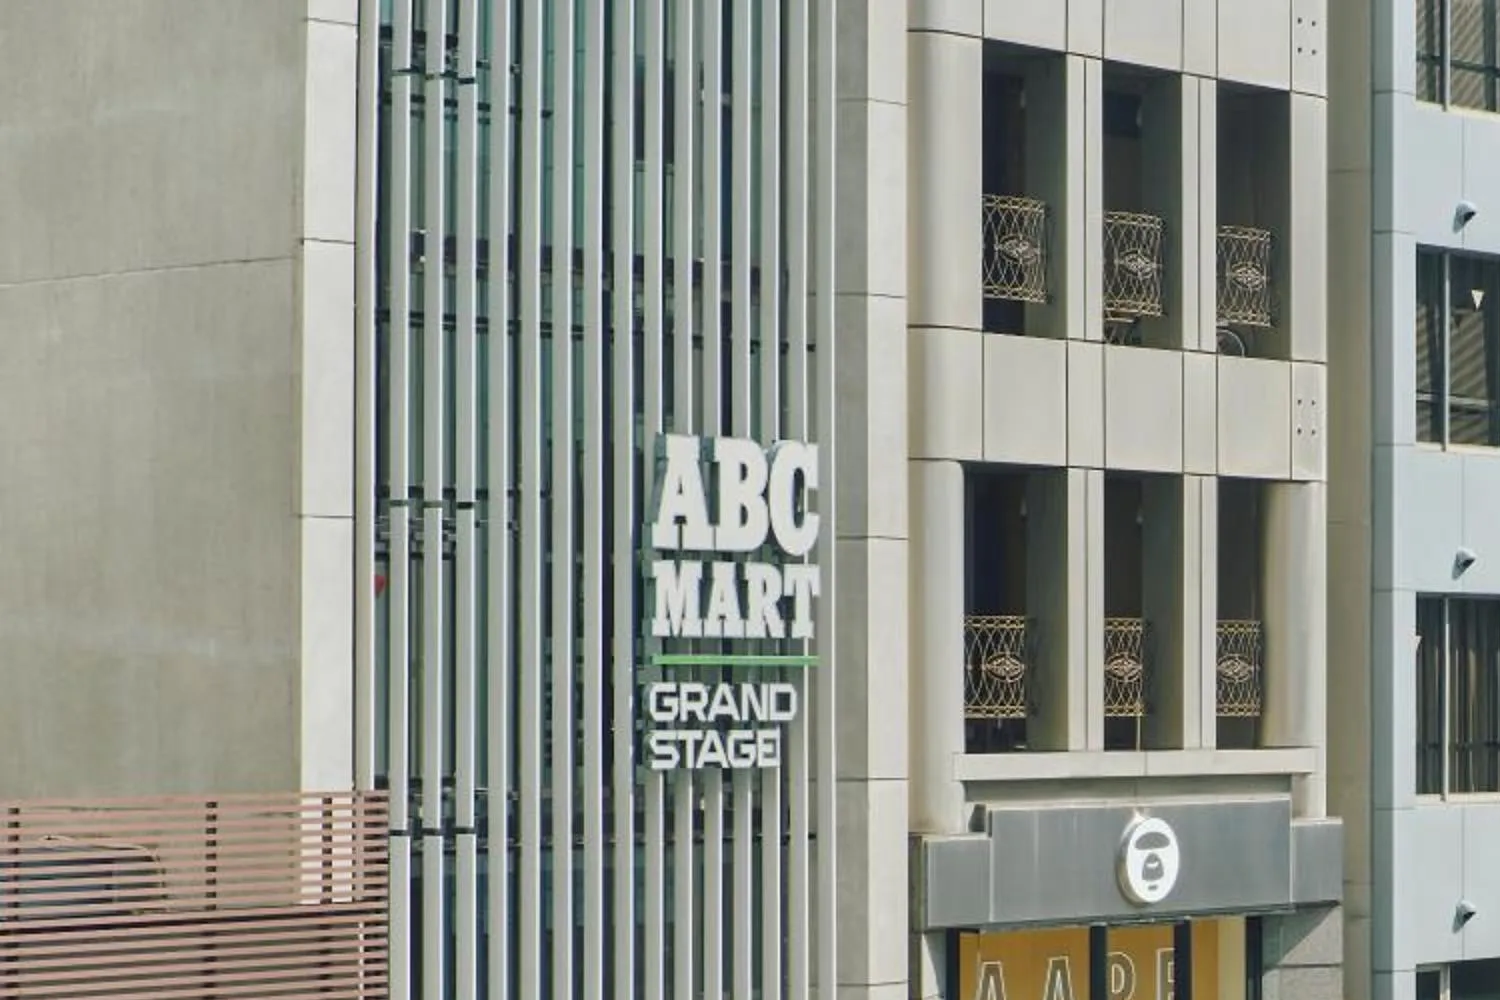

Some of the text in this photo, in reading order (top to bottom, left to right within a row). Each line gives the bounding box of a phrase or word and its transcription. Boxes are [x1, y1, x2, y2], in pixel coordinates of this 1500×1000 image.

[652, 434, 820, 556] ABC
[652, 560, 820, 638] MART
[650, 682, 797, 722] GRAND
[650, 727, 781, 769] STAGE
